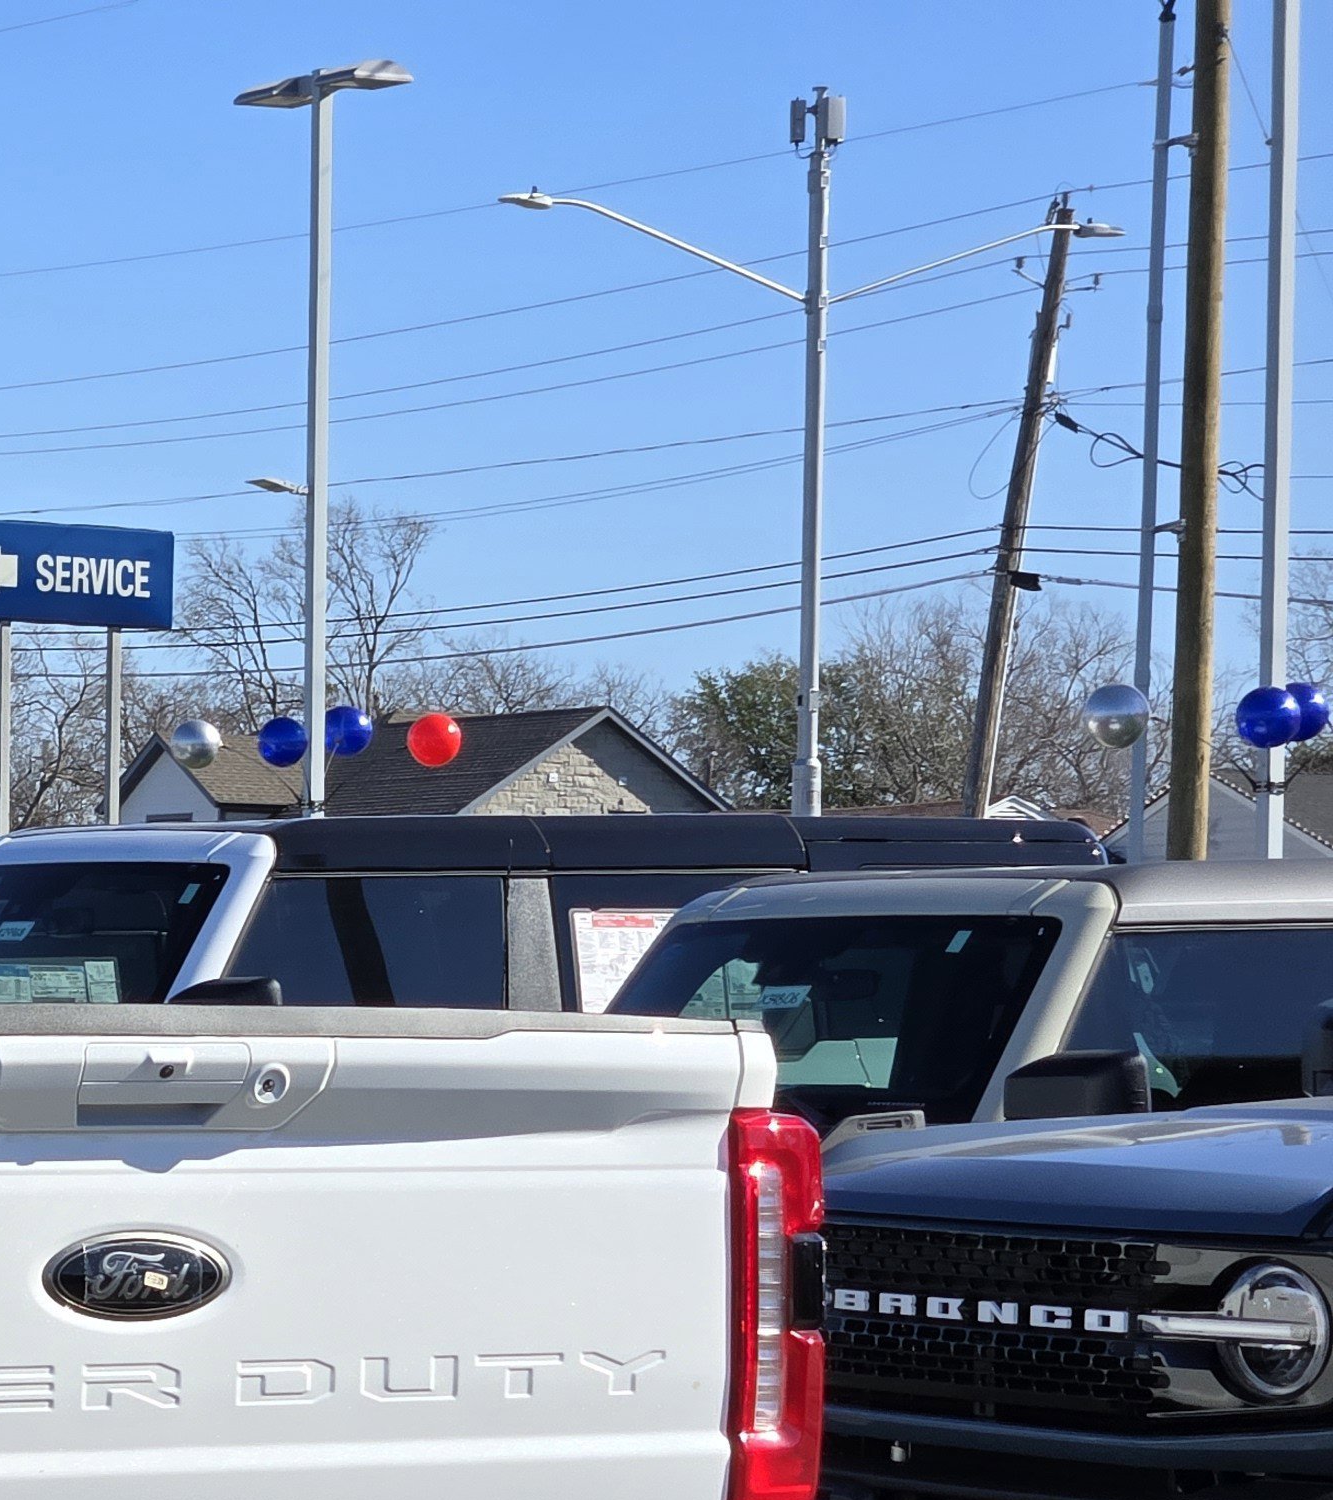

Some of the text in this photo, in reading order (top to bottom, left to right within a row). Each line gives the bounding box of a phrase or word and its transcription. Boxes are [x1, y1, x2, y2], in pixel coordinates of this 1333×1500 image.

[35, 553, 151, 599] SERVICE
[833, 1288, 1129, 1333] BRONCO
[235, 1349, 670, 1408] DUTY
